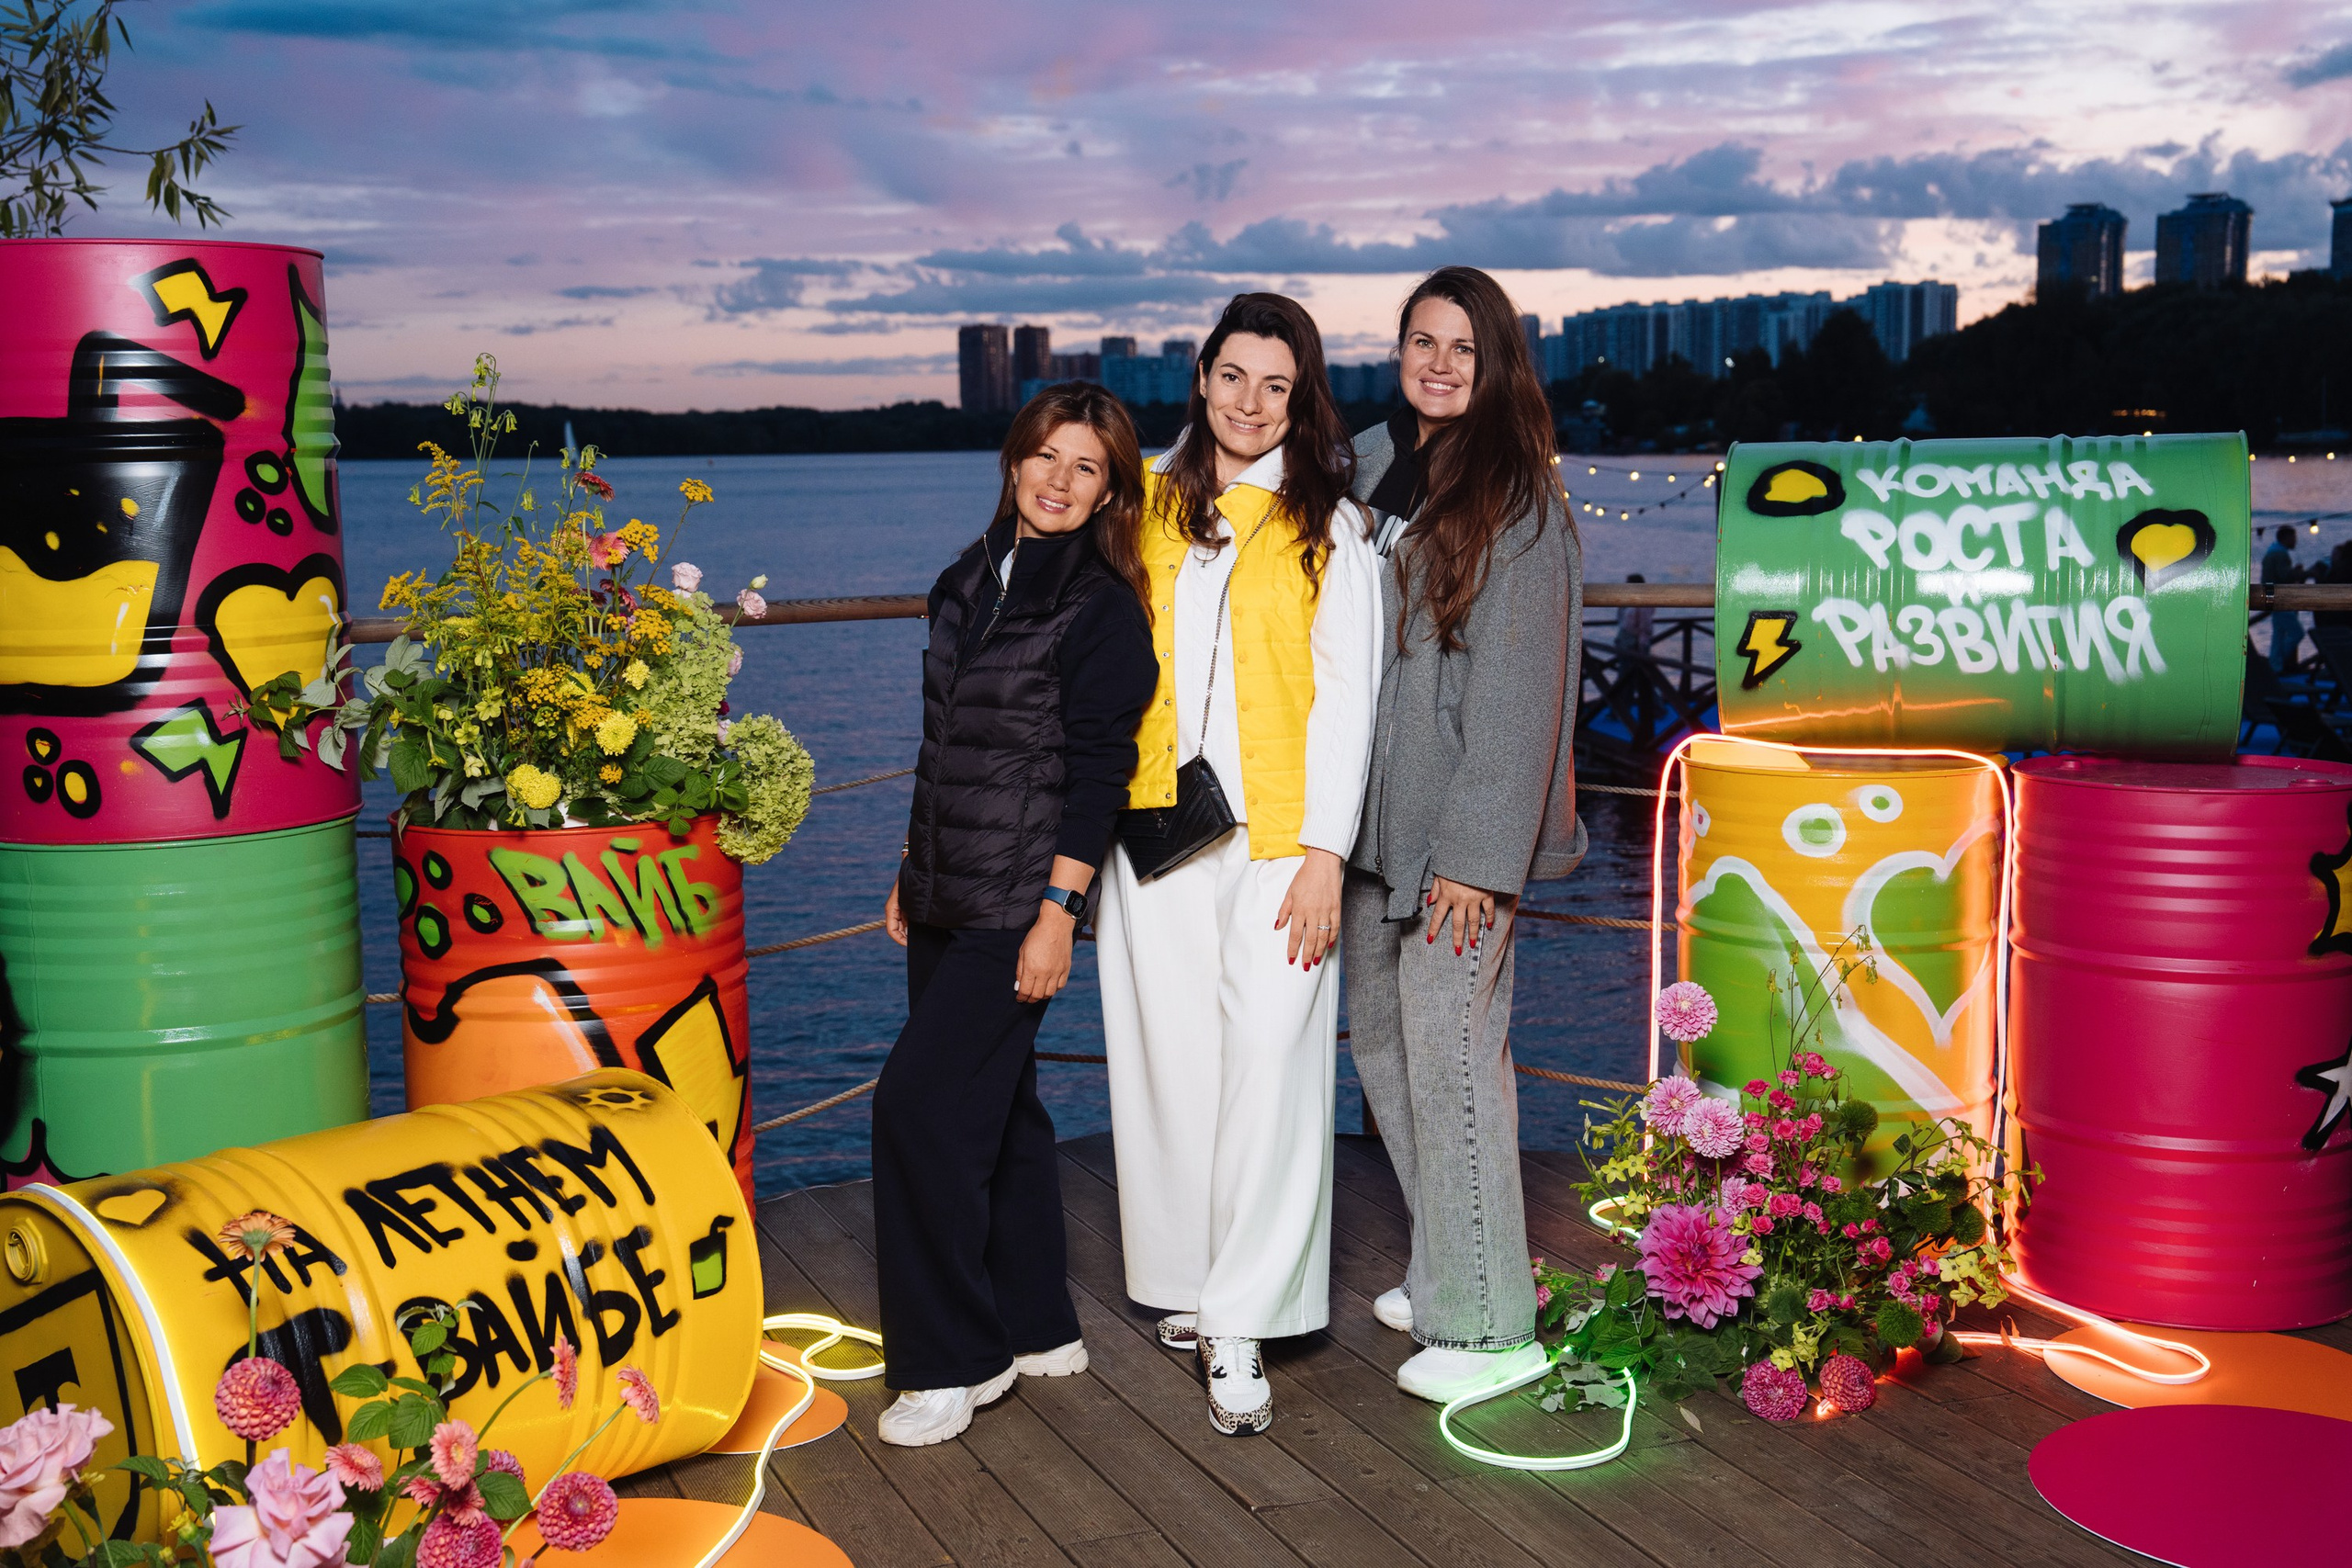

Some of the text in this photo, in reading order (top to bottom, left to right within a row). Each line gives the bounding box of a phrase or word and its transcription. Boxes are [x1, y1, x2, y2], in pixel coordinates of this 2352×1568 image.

[1856, 460, 2154, 502] КОМАНДА
[1840, 502, 2096, 571] РОСТА
[1811, 596, 2166, 685] РАЗВИТИЯ
[488, 837, 720, 950] ВАЙБ
[184, 1122, 656, 1309] НА ЛЕТНЕМ
